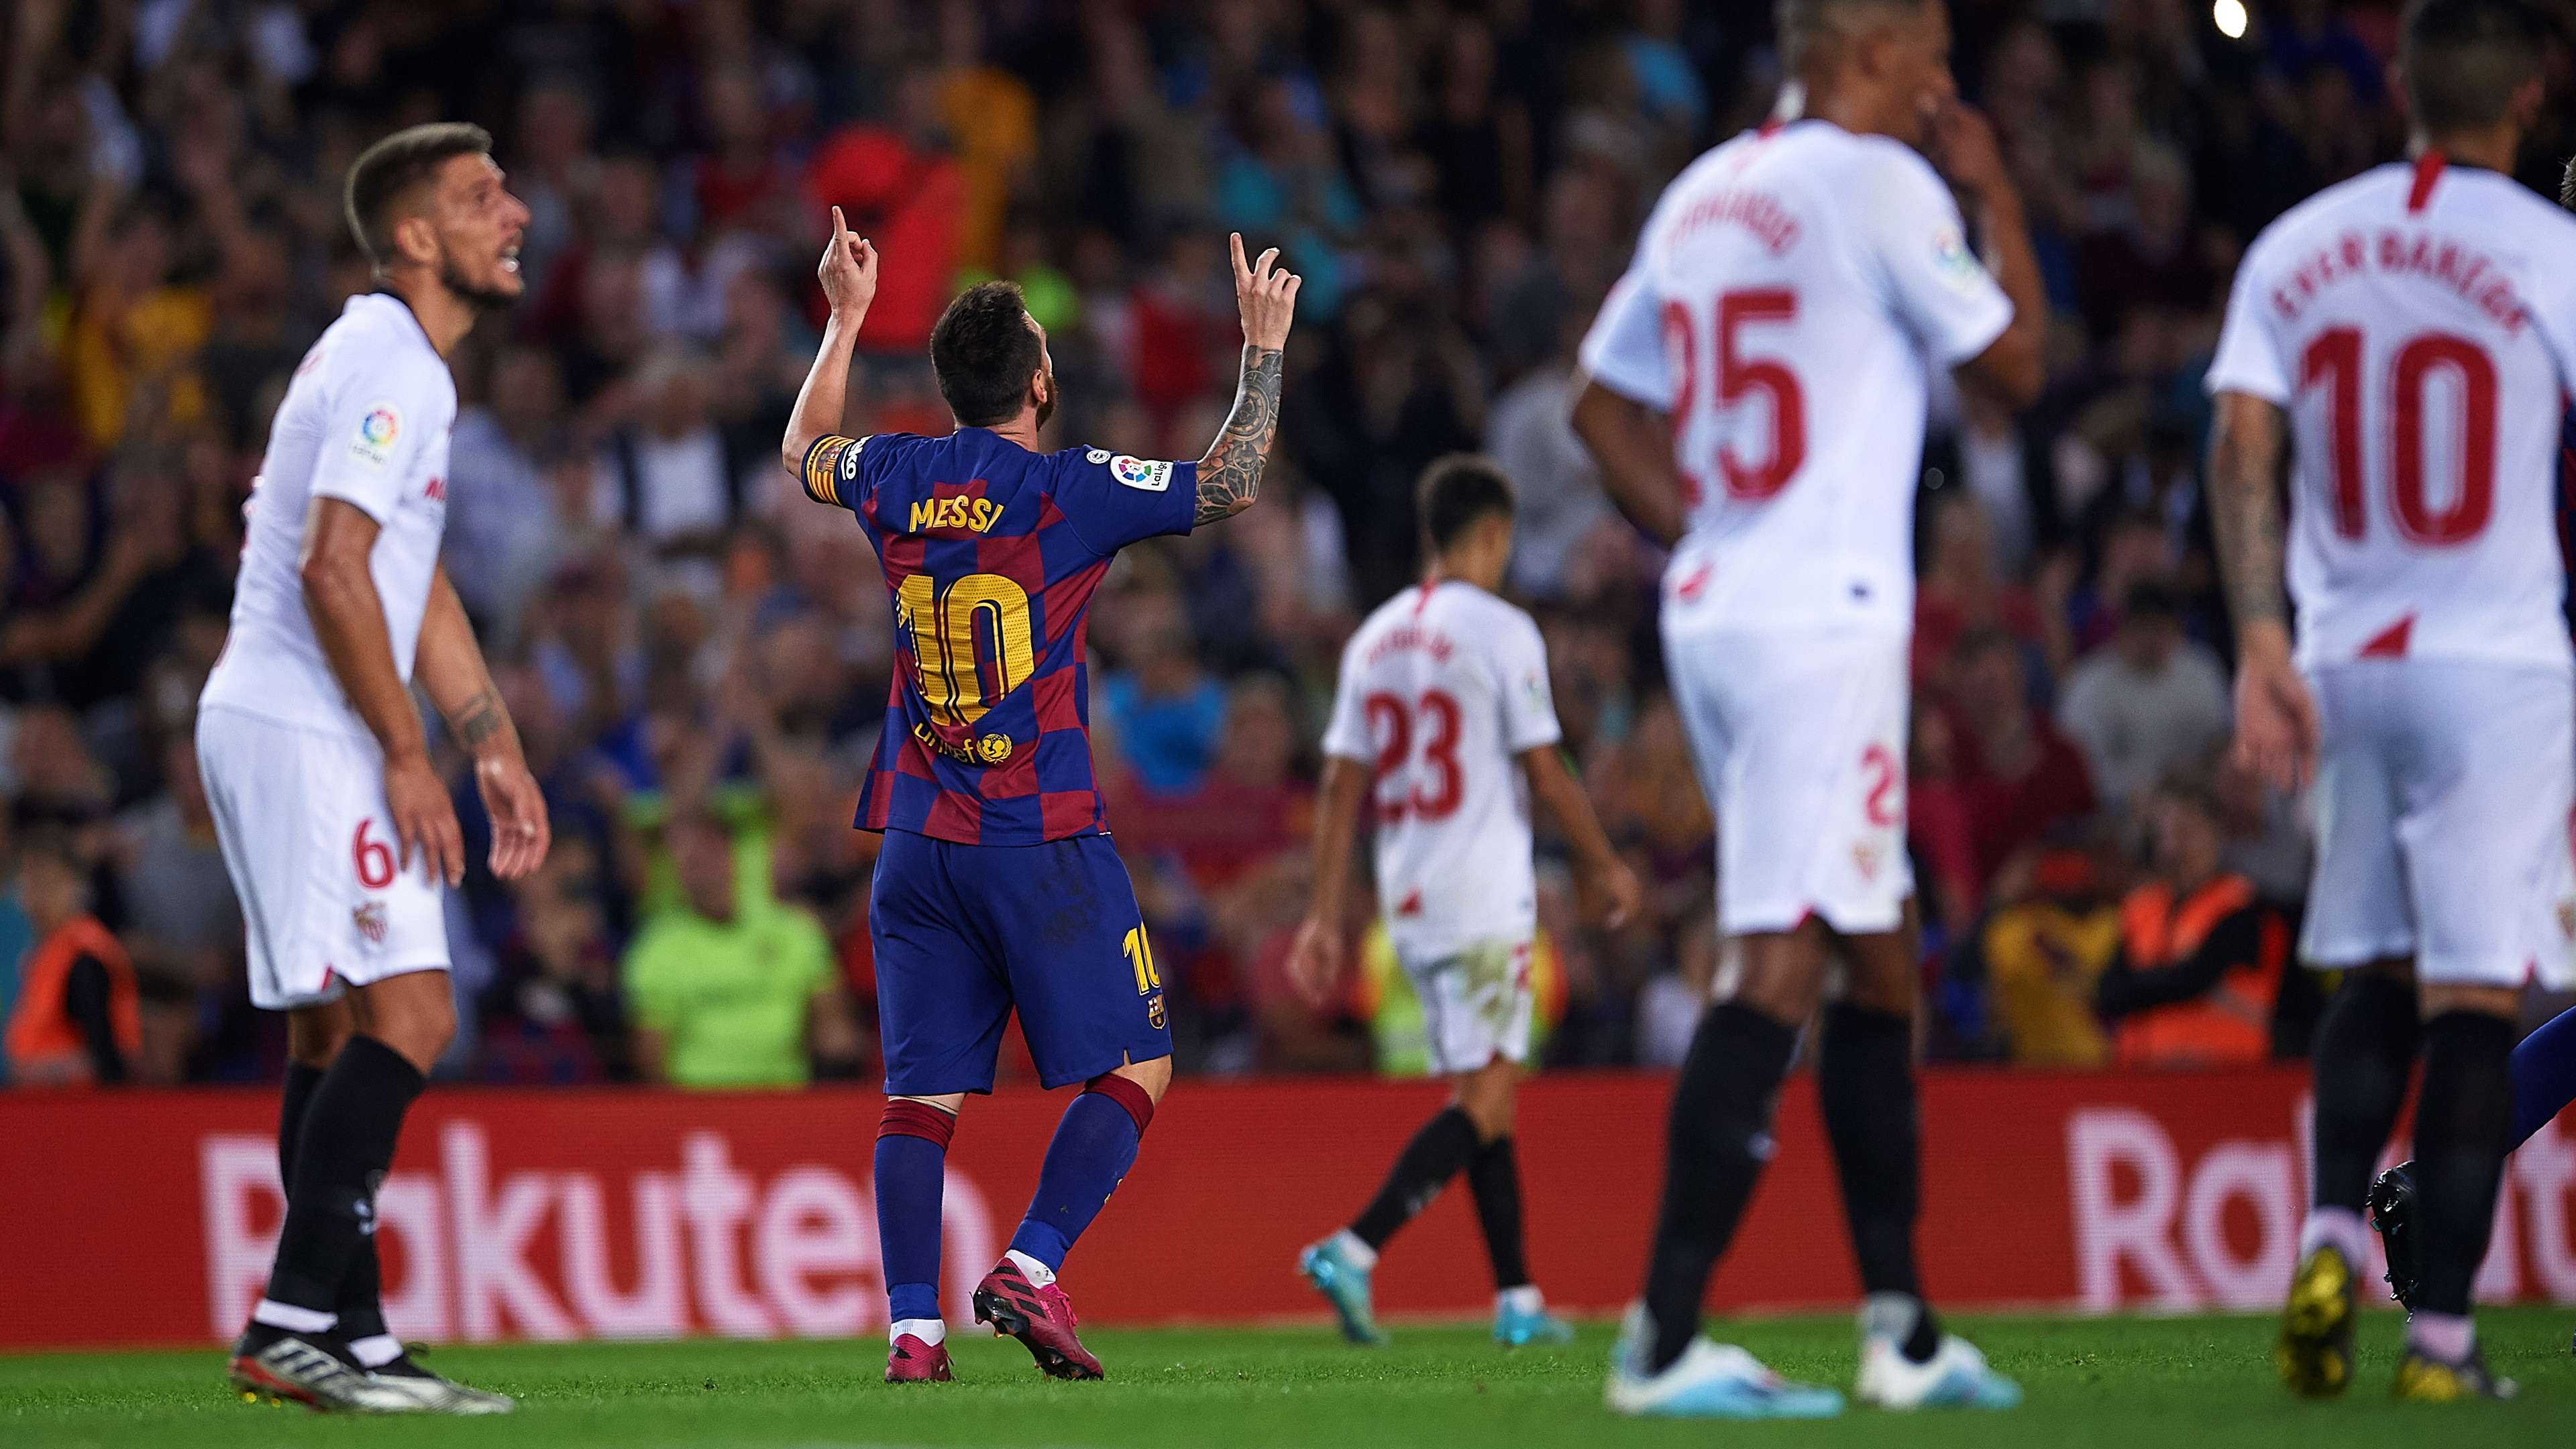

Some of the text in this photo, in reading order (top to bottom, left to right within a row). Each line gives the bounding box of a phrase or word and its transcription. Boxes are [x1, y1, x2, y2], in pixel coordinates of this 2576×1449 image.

[2302, 325, 2498, 547] 10
[908, 495, 1004, 533] MESSI
[896, 574, 1035, 727] 10
[1364, 690, 1464, 822] 23
[351, 818, 396, 888] 6
